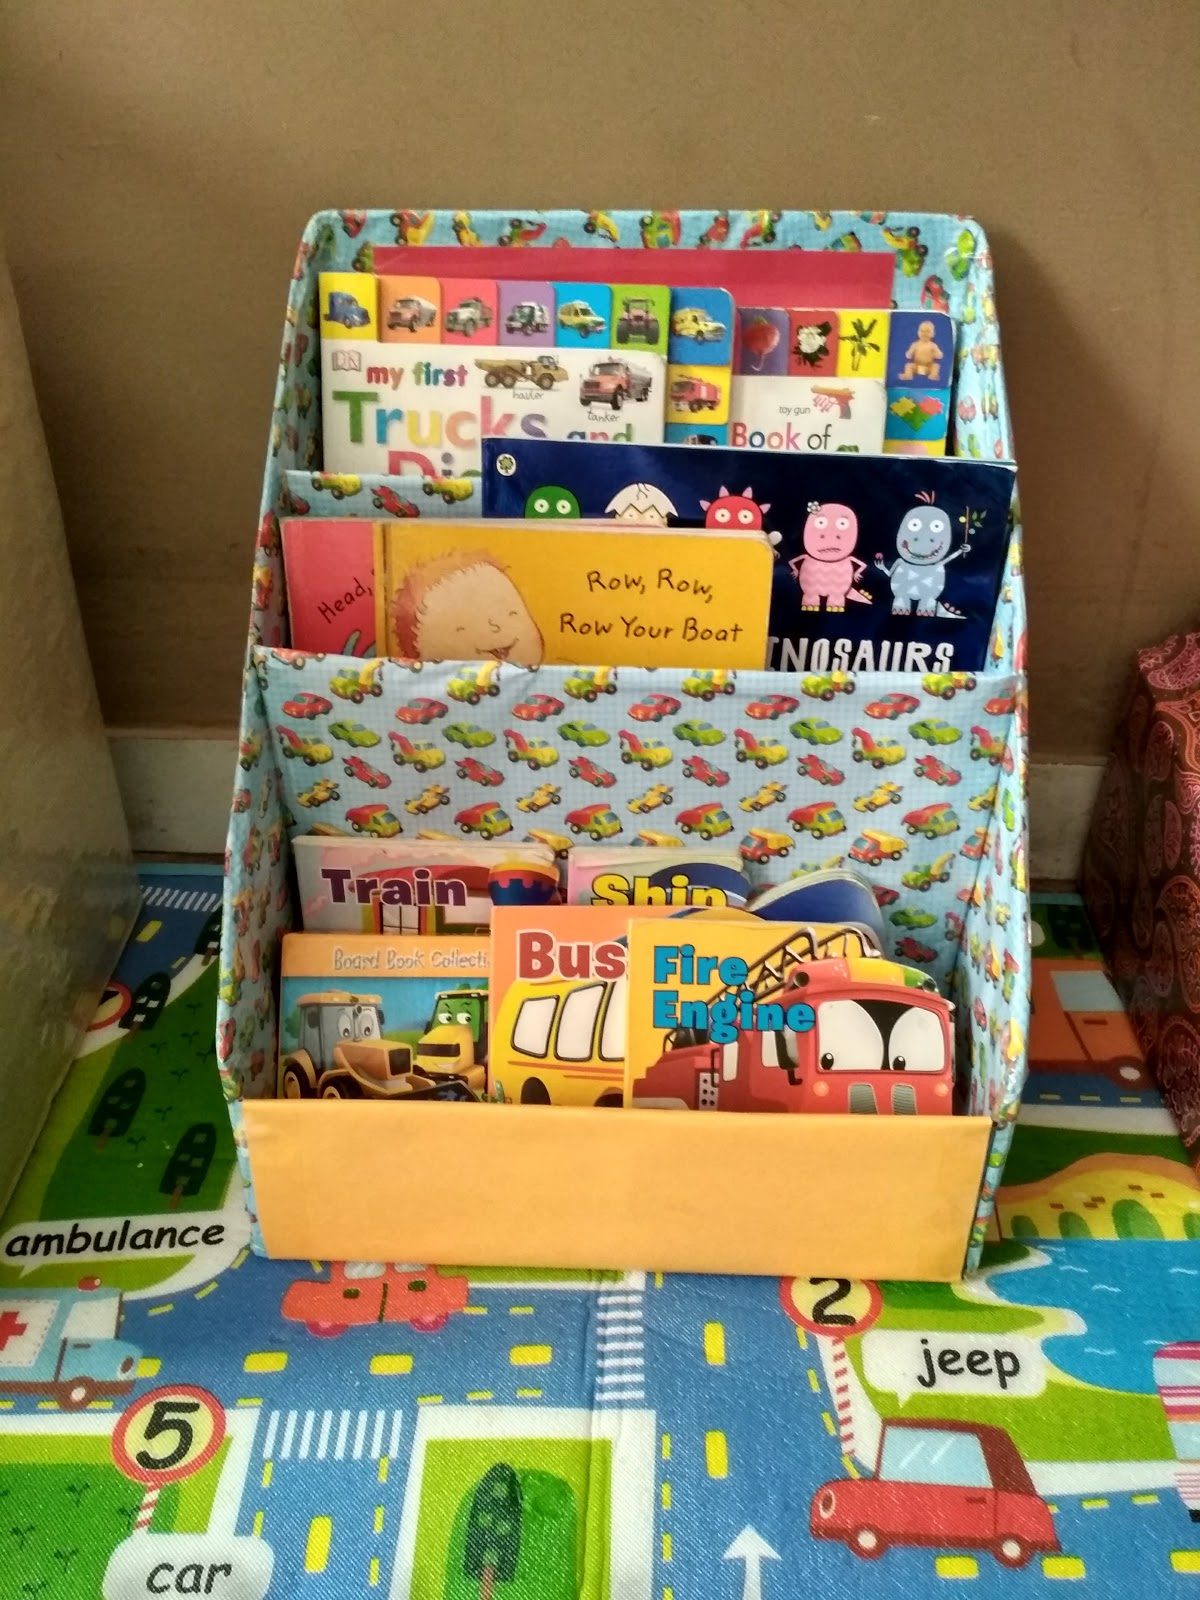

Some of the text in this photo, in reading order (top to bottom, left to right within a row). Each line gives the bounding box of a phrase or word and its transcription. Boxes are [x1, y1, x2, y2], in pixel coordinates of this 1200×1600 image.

[366, 361, 468, 390] my first
[512, 388, 544, 401] hauler
[332, 390, 547, 448] Trucks
[588, 407, 620, 422] tanker
[779, 405, 811, 416] toy gun
[731, 422, 832, 450] Book of
[317, 576, 373, 624] Head,
[586, 568, 713, 603] Row, Row,
[559, 613, 744, 642] Row Your Boat
[321, 867, 467, 907] Train
[334, 947, 489, 970] Board Book Collecti
[516, 929, 627, 981] Bus
[653, 943, 749, 986] Fire
[653, 989, 816, 1044] Engine
[5, 1218, 226, 1257] ambulance
[807, 1277, 857, 1326] 2
[916, 1338, 1020, 1389] jeep
[133, 1401, 200, 1470] 5
[146, 1556, 232, 1595] car
